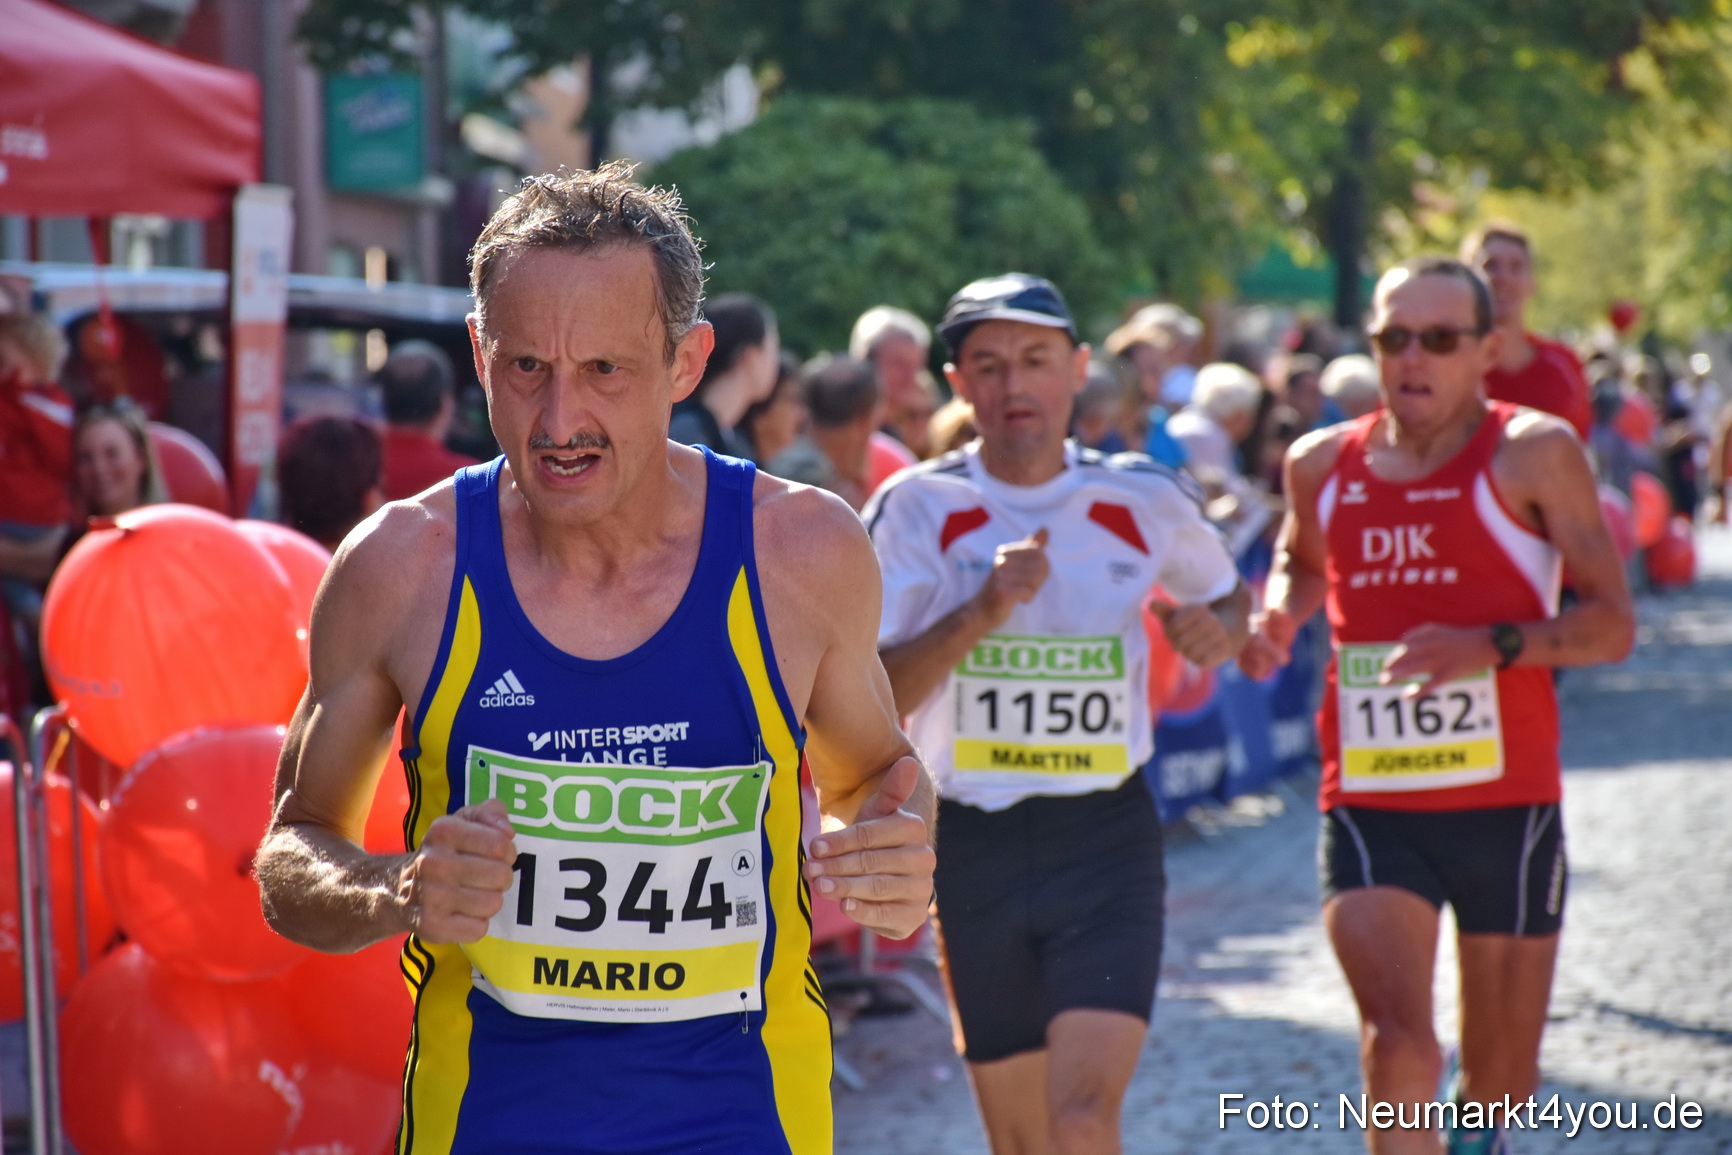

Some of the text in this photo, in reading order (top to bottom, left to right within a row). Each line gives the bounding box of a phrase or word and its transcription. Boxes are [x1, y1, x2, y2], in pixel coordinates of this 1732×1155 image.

[1361, 523, 1436, 569] DJK
[970, 642, 1110, 673] BOCK
[479, 692, 536, 708] adidas
[976, 688, 1110, 735] 1150
[1357, 691, 1475, 738] 1162
[555, 722, 690, 750] INTERSPORT
[990, 748, 1092, 770] MARTIN
[1370, 751, 1467, 774] JÜRGEN
[492, 768, 738, 832] BOCK
[737, 855, 750, 871] A
[512, 852, 732, 934] 1344
[533, 956, 686, 991] MARIO
